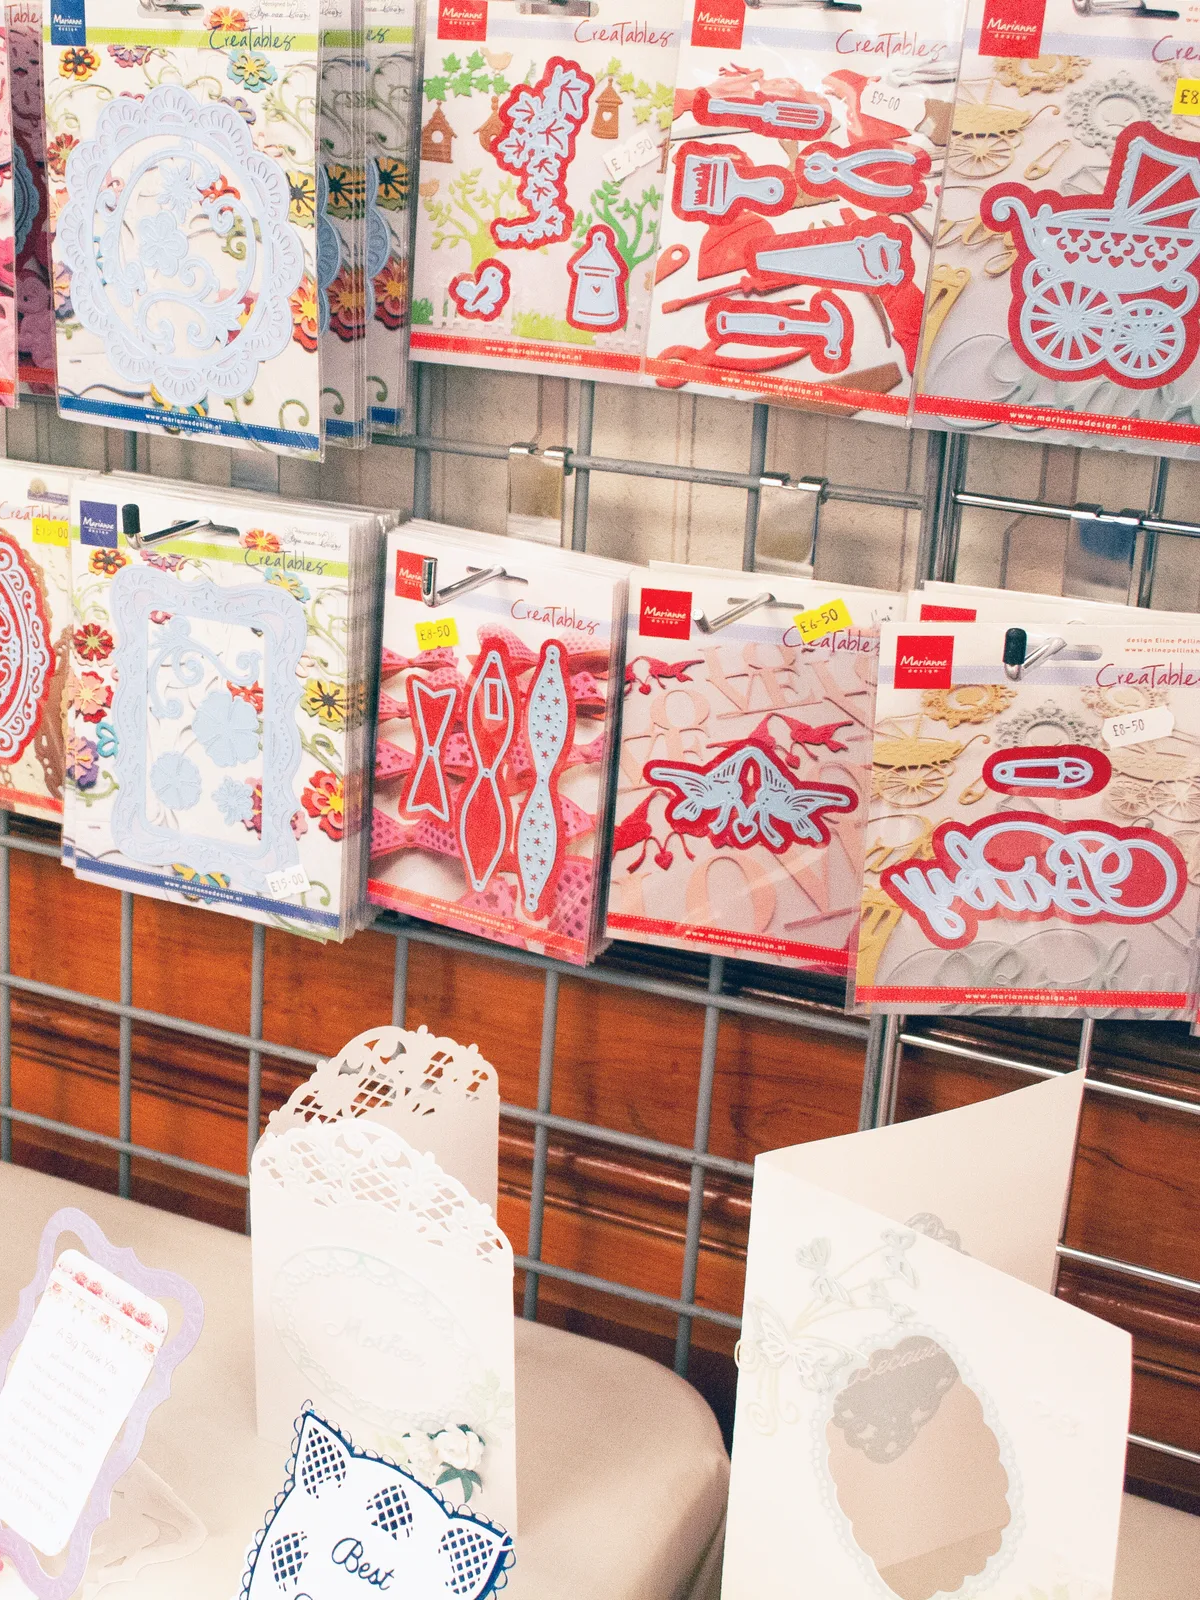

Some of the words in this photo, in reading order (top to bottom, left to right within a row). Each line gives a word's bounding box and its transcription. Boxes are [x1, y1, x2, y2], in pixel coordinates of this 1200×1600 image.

[52, 13, 82, 26] Marianne
[442, 7, 483, 20] Marianne
[697, 11, 740, 26] Marianne
[574, 20, 674, 47] CreaTables
[986, 17, 1037, 33] Marianne
[208, 26, 296, 51] CreaTables
[835, 29, 949, 60] CreaTables
[994, 33, 1028, 41] design
[485, 345, 582, 361] www.mariannedesign.nl
[721, 375, 823, 397] www.mariannedesign.nl
[1009, 411, 1132, 432] www.mariannedesign.nl
[83, 515, 115, 530] Marianne
[244, 547, 327, 576] CreaTables
[399, 567, 422, 581] Maria
[511, 599, 601, 636] CreaTables
[644, 605, 686, 620] Marianne
[799, 608, 839, 634] £6-50
[783, 625, 880, 656] CeaTable
[900, 655, 948, 668] Marianne
[1095, 662, 1200, 689] CreaTable
[685, 929, 786, 951] www.mariannedesign.nl
[965, 991, 1078, 1003] www.mariannedesign.nl
[331, 1537, 395, 1591] Best
